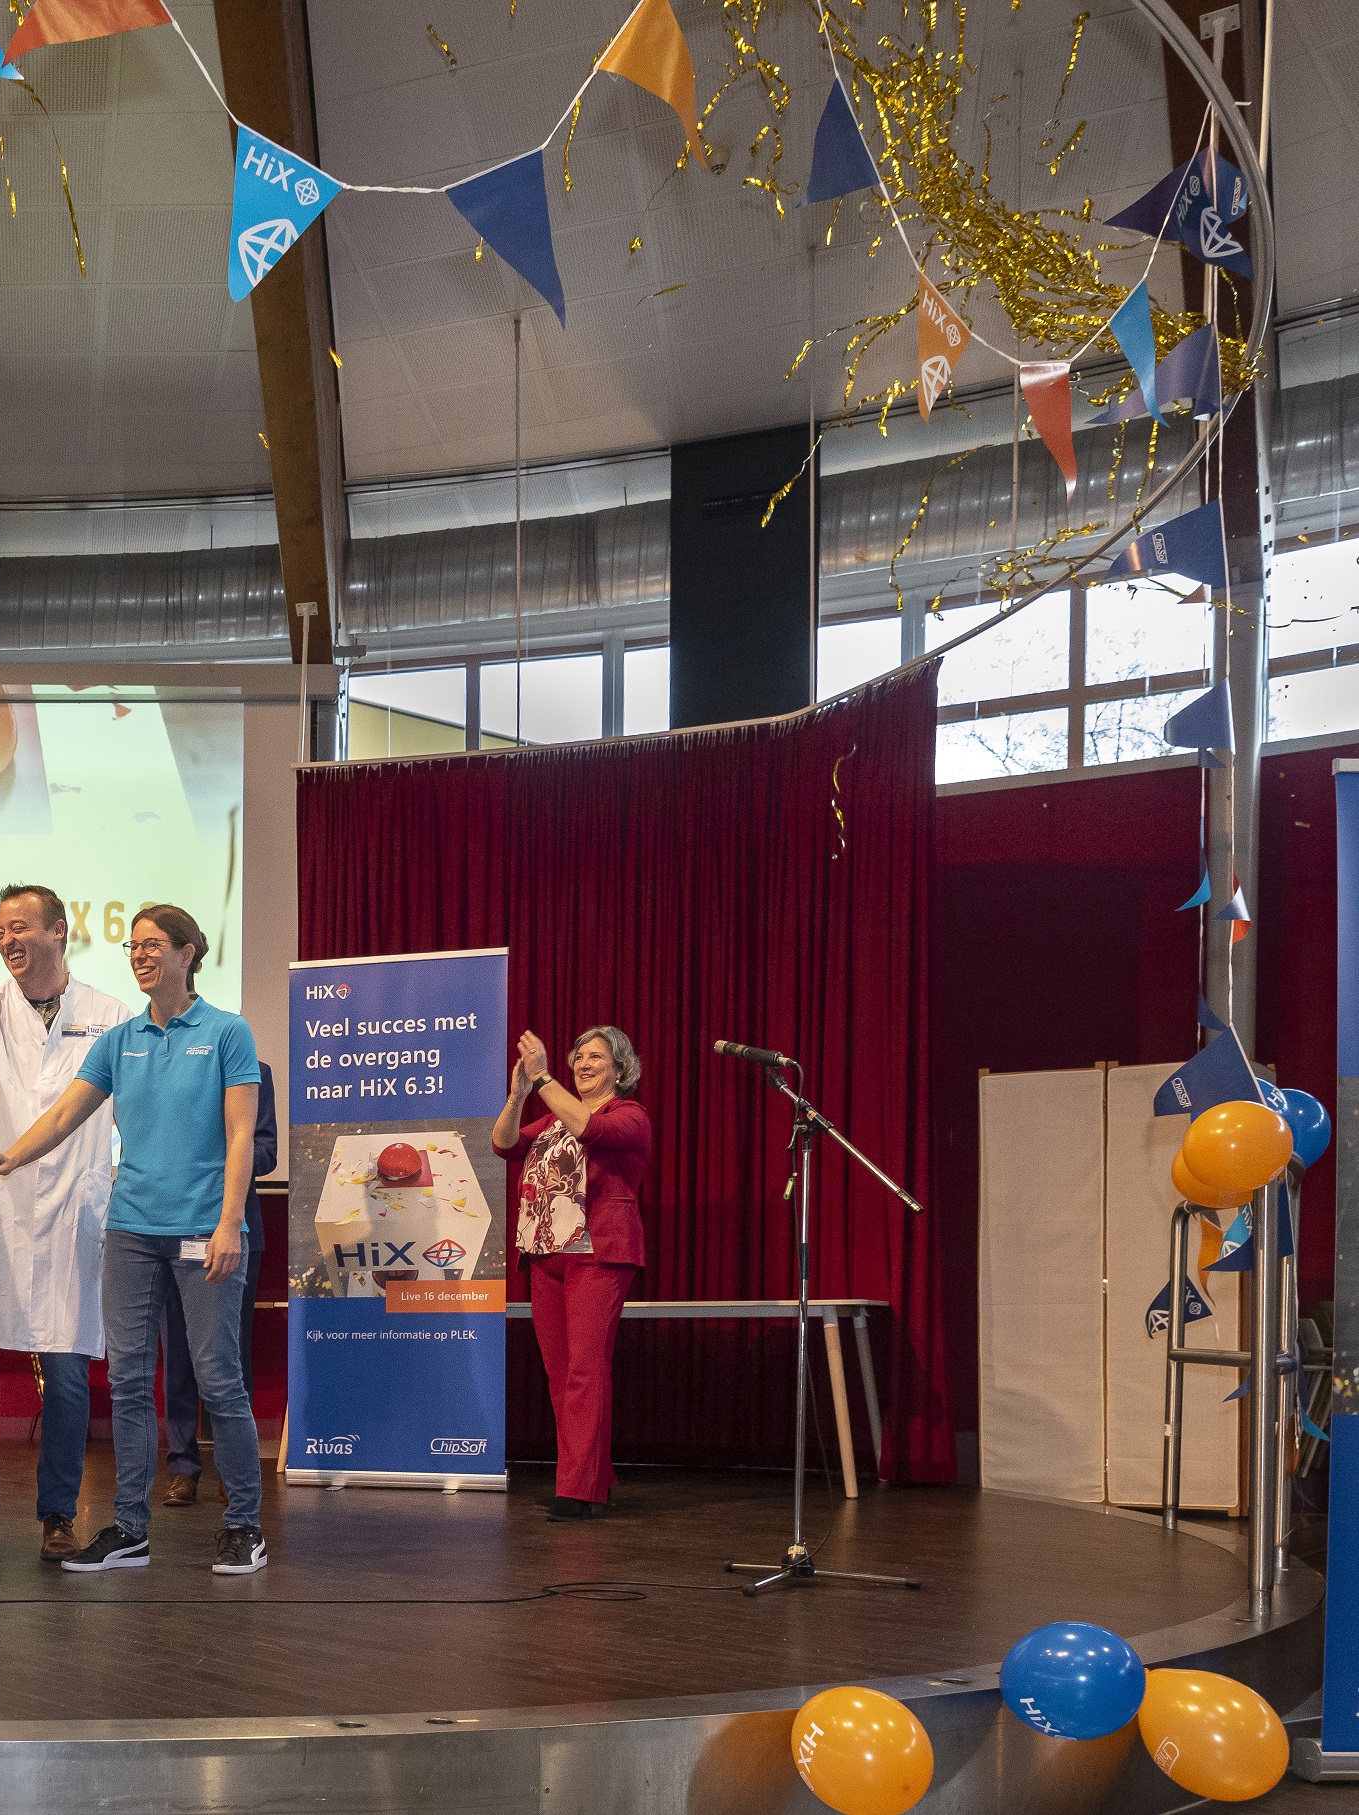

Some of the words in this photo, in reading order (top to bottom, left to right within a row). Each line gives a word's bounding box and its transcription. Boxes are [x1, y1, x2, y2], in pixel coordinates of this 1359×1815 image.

[242, 145, 296, 193] HiX
[922, 289, 948, 334] HiX
[306, 984, 336, 1000] HiX
[305, 1018, 350, 1038] Veel
[357, 1017, 427, 1036] succes
[434, 1012, 478, 1031] met
[305, 1050, 332, 1069] de
[338, 1048, 441, 1070] overgang
[306, 1083, 353, 1100] naar
[359, 1077, 398, 1097] HiX
[404, 1075, 444, 1095] 6.3!
[333, 1241, 417, 1268] HiX
[401, 1292, 421, 1301] Live
[423, 1292, 435, 1301] 16
[437, 1291, 490, 1301] december
[306, 1330, 324, 1342] Kijk
[326, 1332, 349, 1340] voor
[351, 1332, 377, 1340] meer
[379, 1330, 431, 1340] informatie
[434, 1331, 448, 1342] op
[450, 1330, 478, 1340] PLEK.
[305, 1437, 353, 1455] Rivas
[430, 1437, 488, 1456] ChipSoft
[1019, 1697, 1061, 1734] HiX
[798, 1721, 825, 1774] HiX
